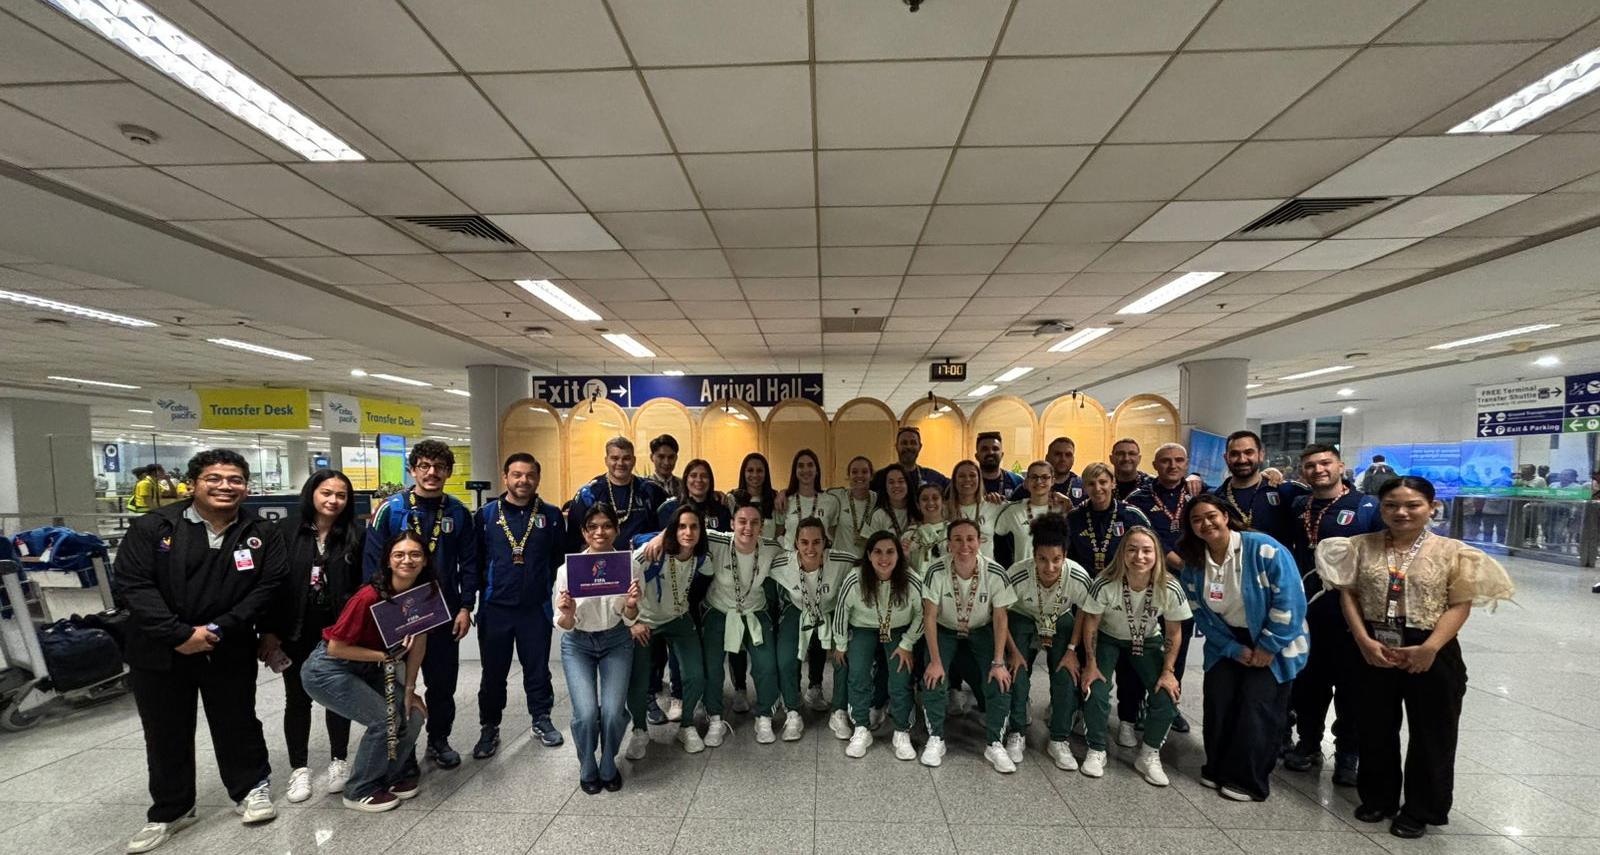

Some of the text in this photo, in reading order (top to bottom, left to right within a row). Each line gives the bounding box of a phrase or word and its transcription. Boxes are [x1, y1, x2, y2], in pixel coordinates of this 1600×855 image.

[938, 365, 963, 376] 17:00
[534, 380, 580, 403] Exit
[700, 378, 802, 402] Arrival Hall
[1503, 385, 1537, 394] Terminal
[170, 403, 189, 412] cebu
[209, 404, 294, 416] Transfer Desk
[171, 411, 197, 421] pacific
[366, 412, 415, 426] Transfer Desk
